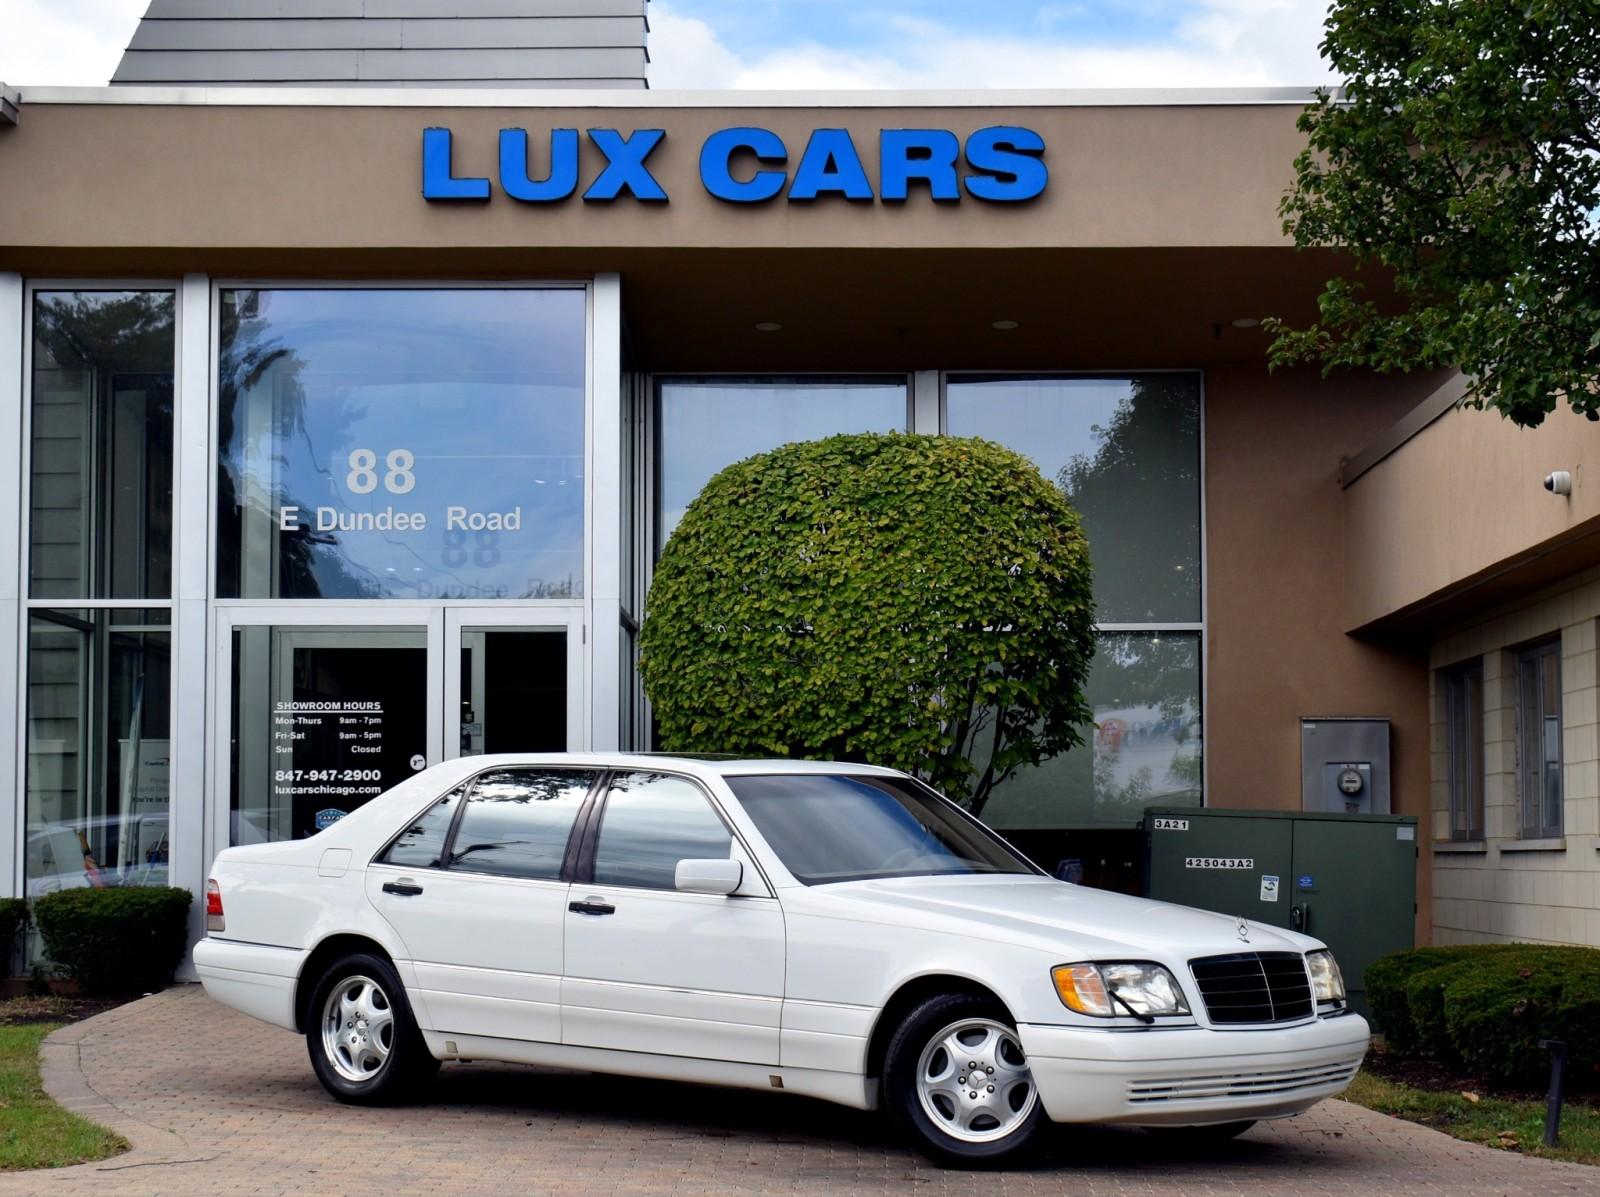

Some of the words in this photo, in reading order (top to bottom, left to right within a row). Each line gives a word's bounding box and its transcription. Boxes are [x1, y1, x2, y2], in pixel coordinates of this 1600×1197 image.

[422, 126, 669, 204] LUX
[700, 125, 1049, 204] CARS
[346, 448, 416, 494] 88
[280, 506, 298, 531] E
[317, 506, 427, 531] Dundee
[447, 506, 521, 531] Road
[276, 701, 341, 710] SHOWROOM
[343, 701, 381, 710] HOURS
[275, 717, 322, 725] Mon-Thurs
[339, 716, 357, 724] 9am
[364, 716, 382, 725] 7pm
[275, 732, 305, 740] Fri-Sat
[339, 731, 357, 739] 9am
[364, 731, 382, 740] 5pm
[275, 770, 381, 781] 847-947-2900
[275, 785, 381, 796] luxcarschicago.com
[1155, 820, 1188, 830] 3A21
[1186, 859, 1253, 868] 425043A2
